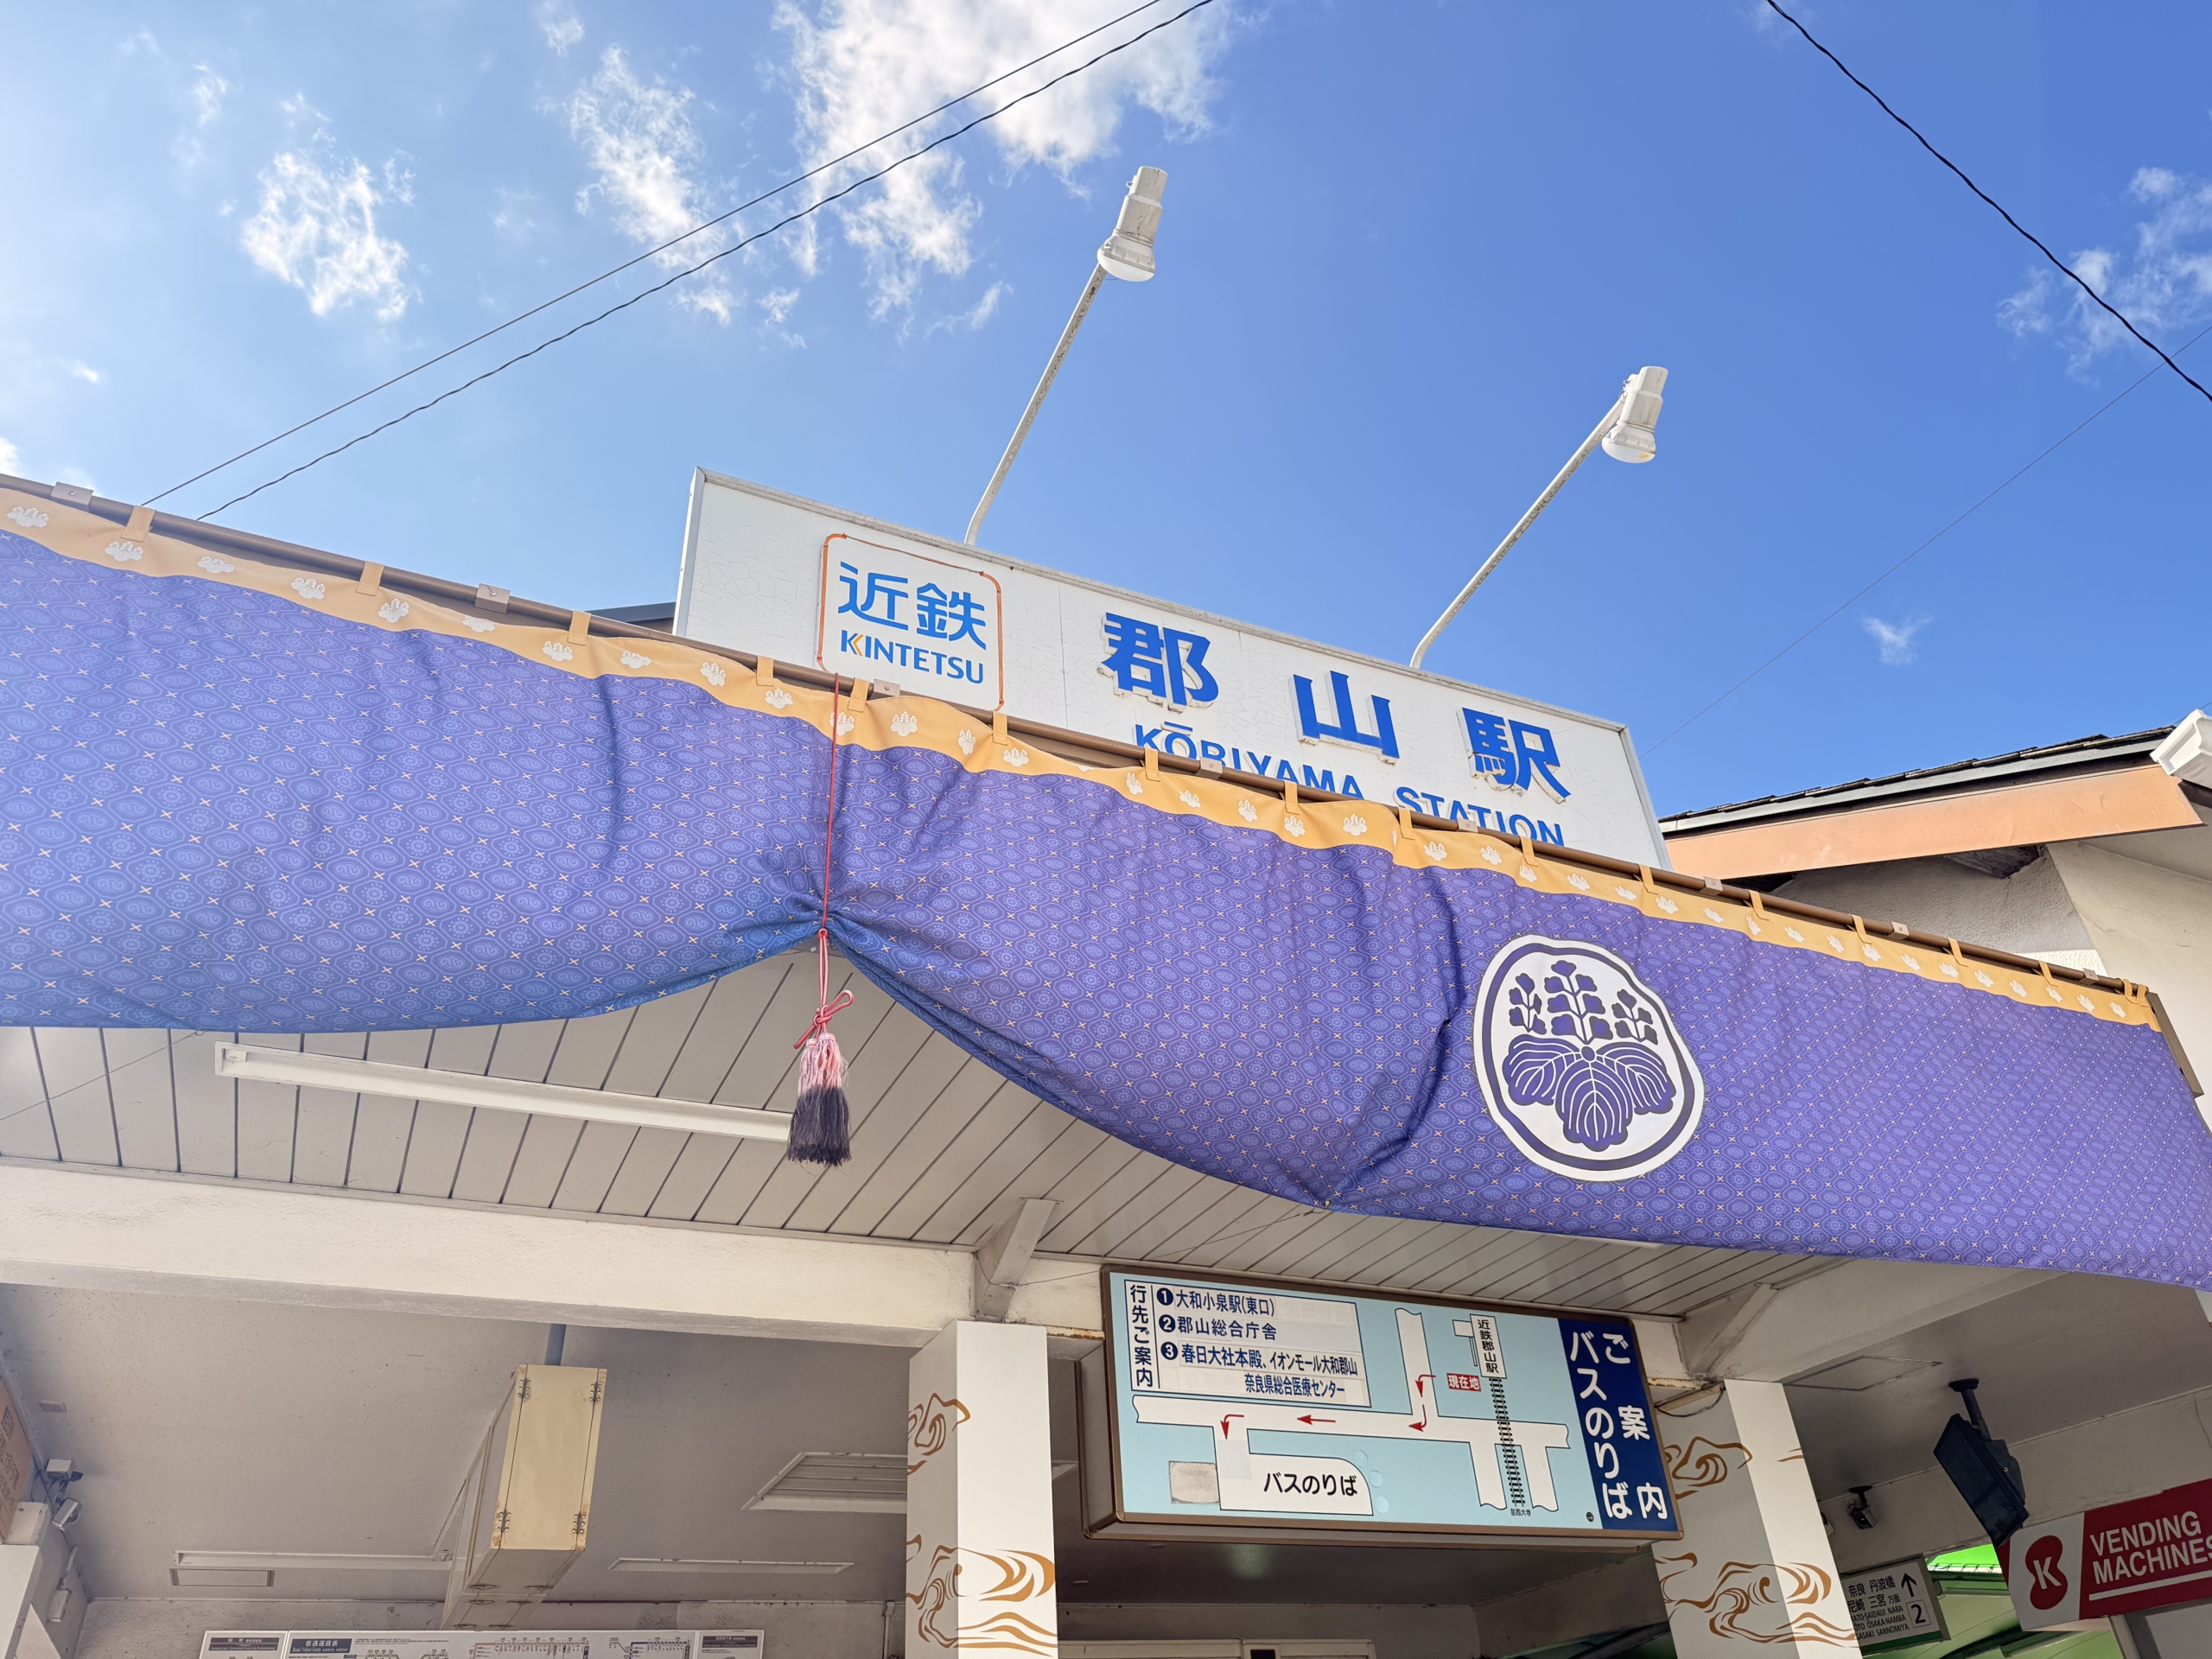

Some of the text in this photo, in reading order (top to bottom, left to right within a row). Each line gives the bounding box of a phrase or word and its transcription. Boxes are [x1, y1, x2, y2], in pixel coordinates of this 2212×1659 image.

[838, 561, 986, 651] 近鉄
[841, 629, 983, 684] KINTETSU
[1129, 1284, 1154, 1388] 行先ご案内
[1177, 1316, 1277, 1340] 郡山総合庁舎
[1477, 1319, 1499, 1374] 近鉄郡山駅
[1244, 1373, 1345, 1398] 奈良県総合医療センター
[1447, 1375, 1481, 1391] 現在地
[1570, 1331, 1632, 1519] バスのりば
[1263, 1472, 1358, 1496] バスのりば
[2089, 1510, 2202, 1556] VENDING
[2032, 1556, 2063, 1590] K
[1847, 1575, 1897, 1598] 奈良 丹波橋
[1868, 1593, 1886, 1608] 三宮
[1887, 1593, 1901, 1605] 方面
[1851, 1605, 1904, 1622] ATO-SAIDAIJI NARA
[1910, 1604, 1926, 1624] 2
